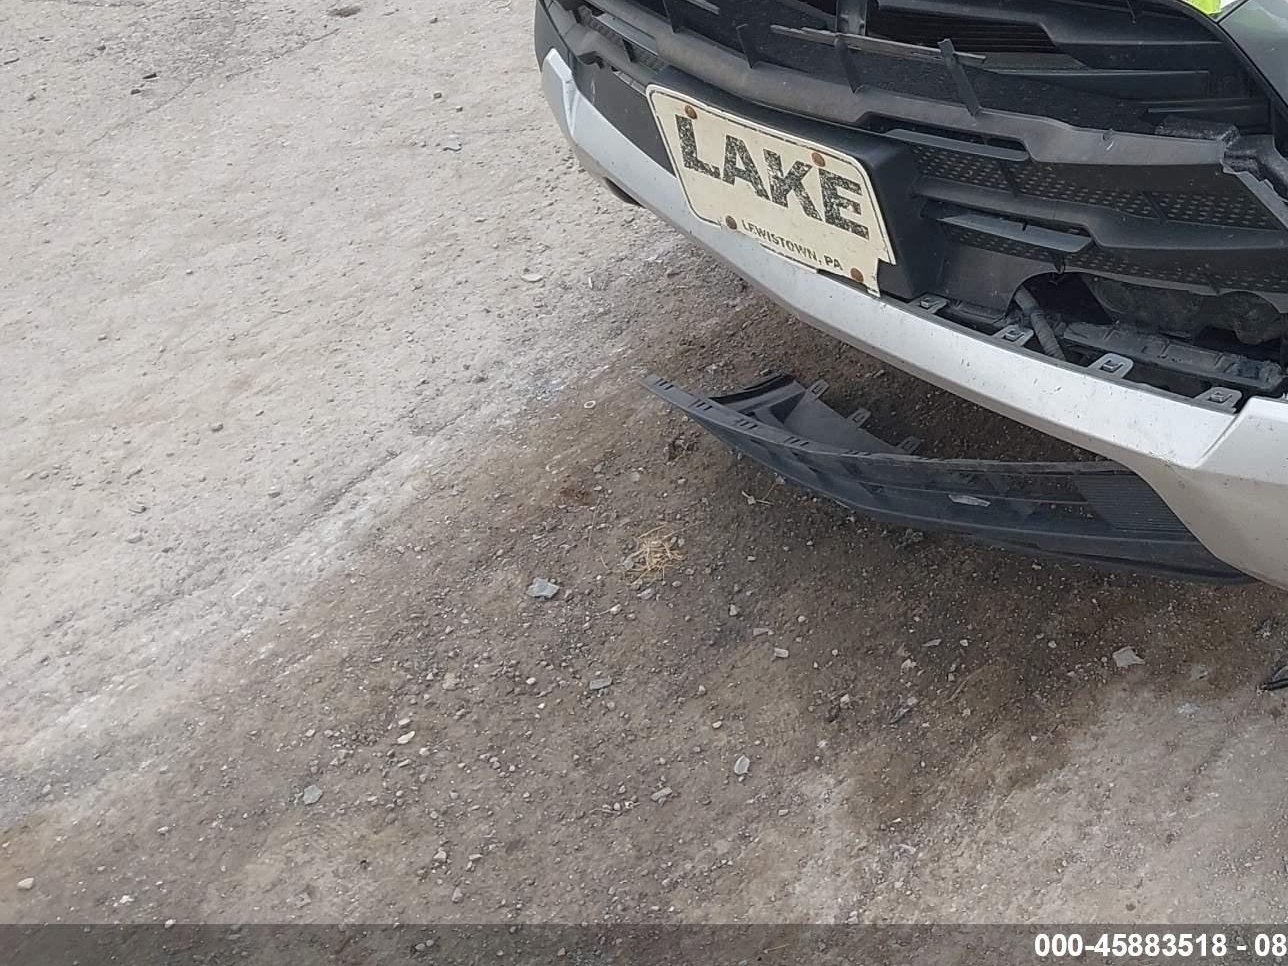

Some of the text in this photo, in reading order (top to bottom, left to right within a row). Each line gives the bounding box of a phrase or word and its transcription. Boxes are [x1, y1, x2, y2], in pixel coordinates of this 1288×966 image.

[676, 115, 869, 240] LAKE
[742, 220, 844, 271] LEWISTOWN, PA
